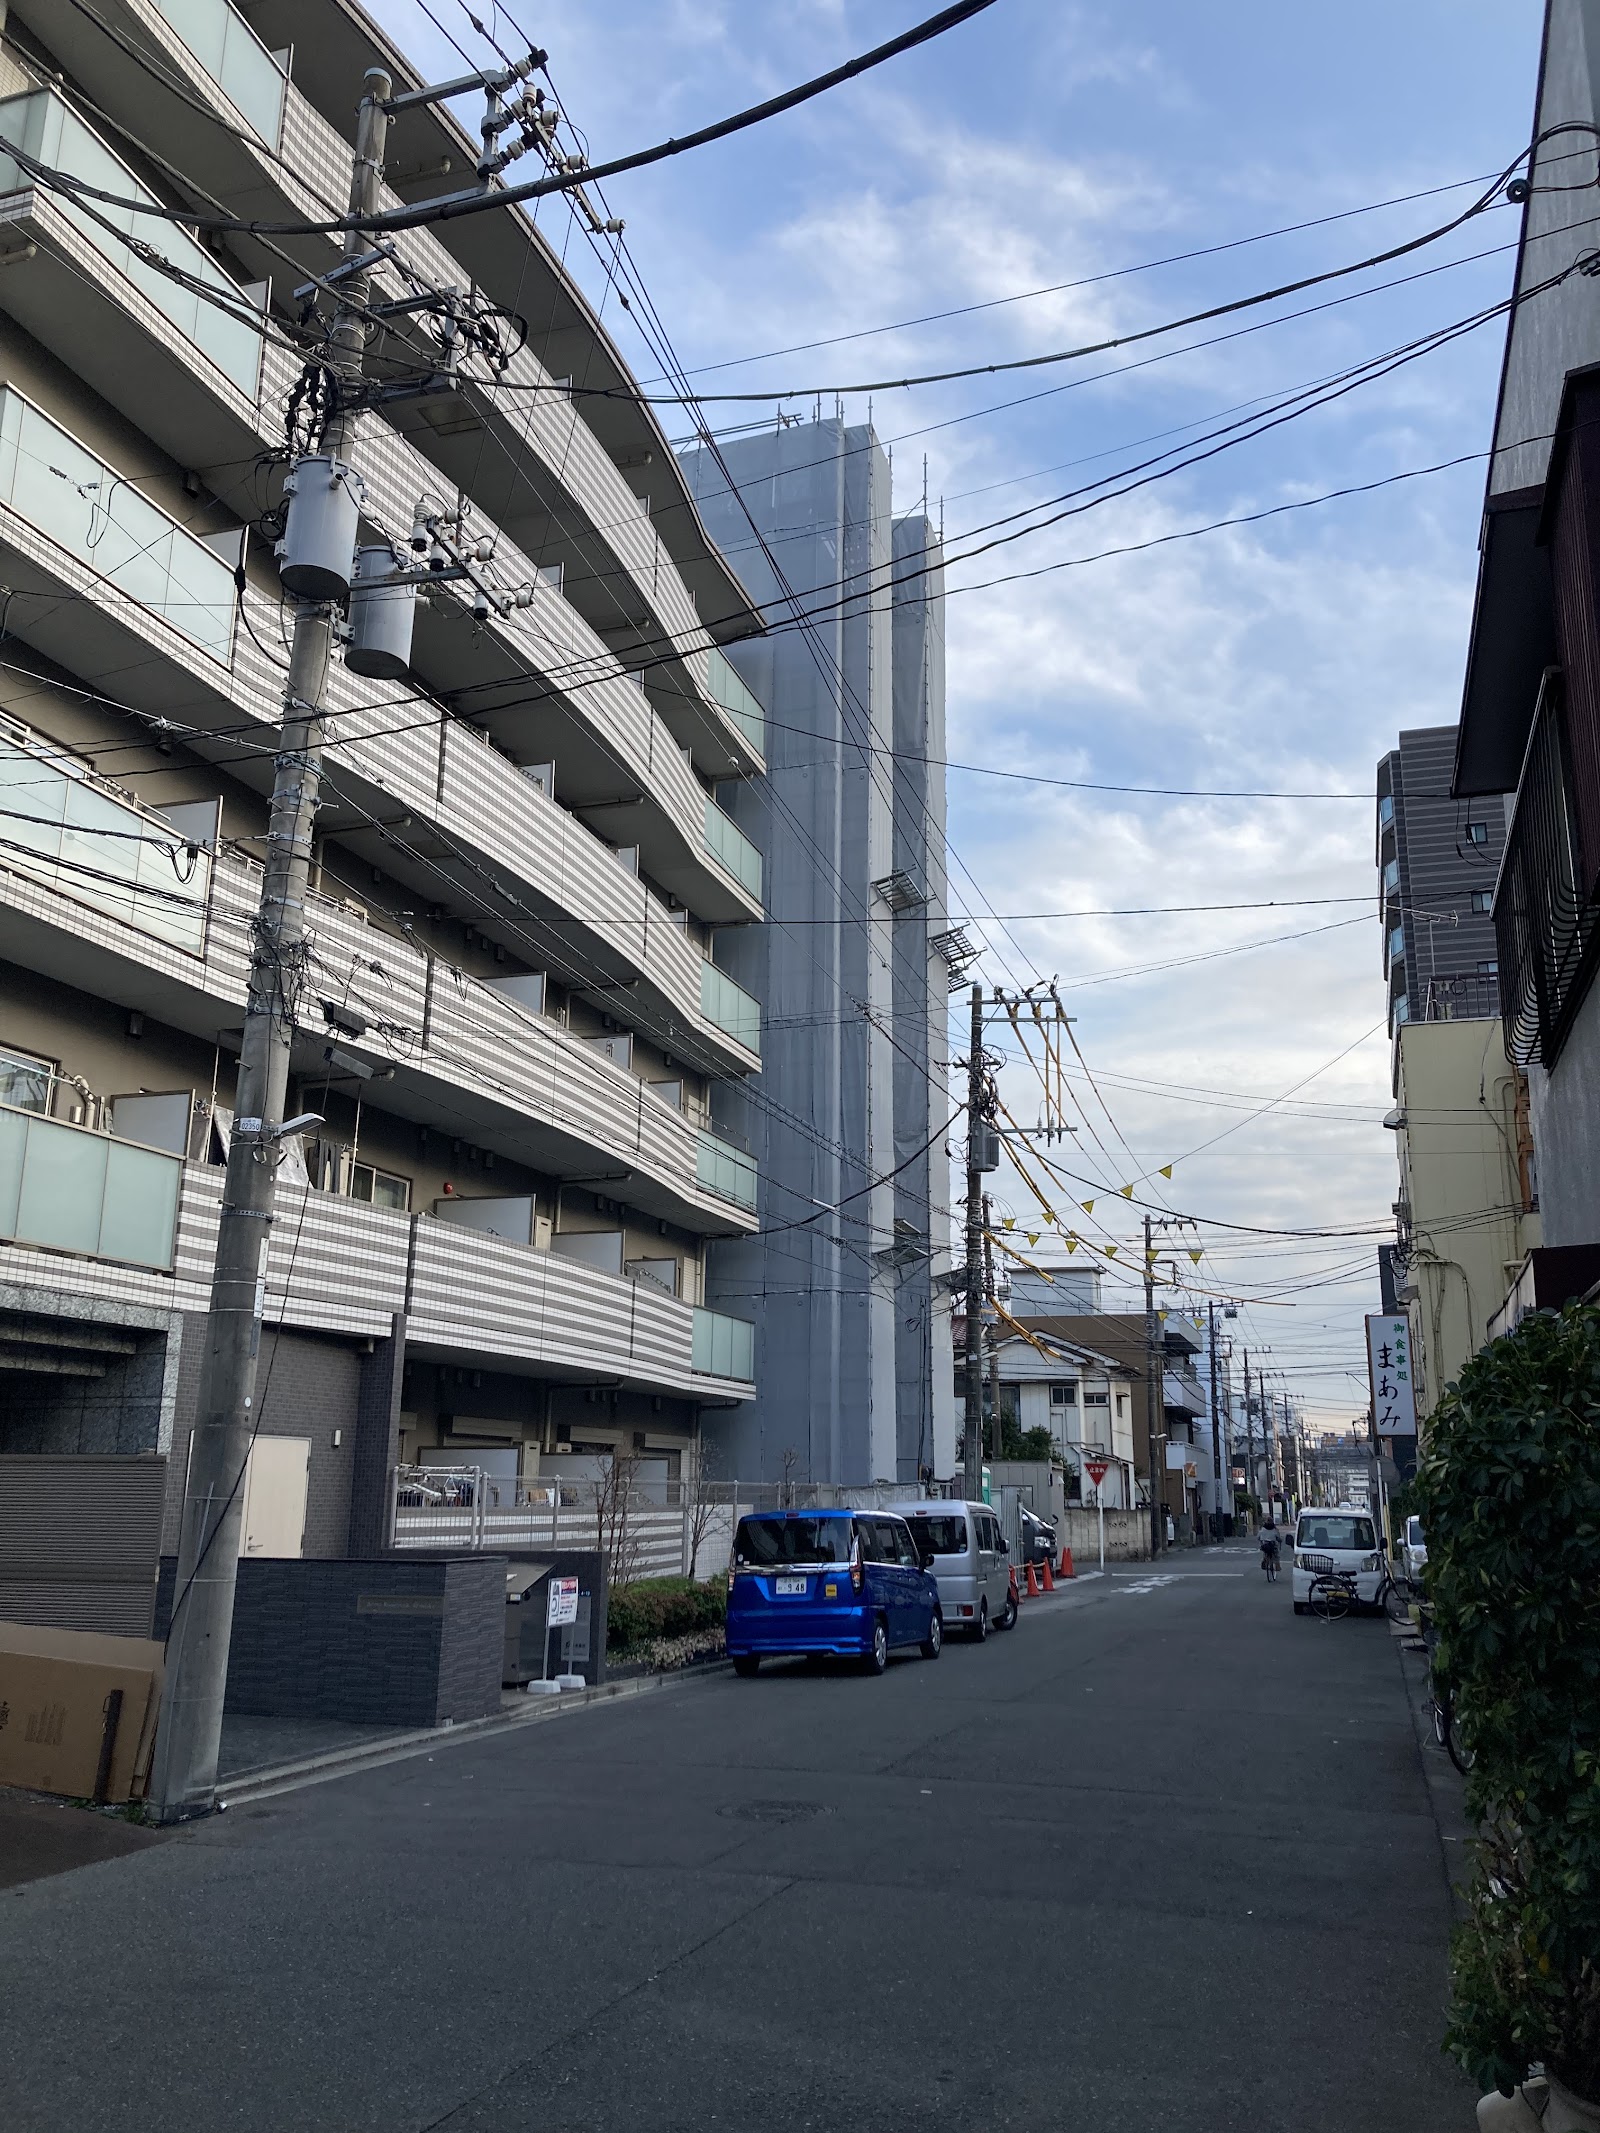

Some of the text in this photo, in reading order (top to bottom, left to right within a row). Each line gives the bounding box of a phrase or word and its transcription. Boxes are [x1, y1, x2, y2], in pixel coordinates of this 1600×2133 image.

[1376, 1341, 1401, 1428] まあみ
[1393, 1323, 1408, 1381] 御食事処
